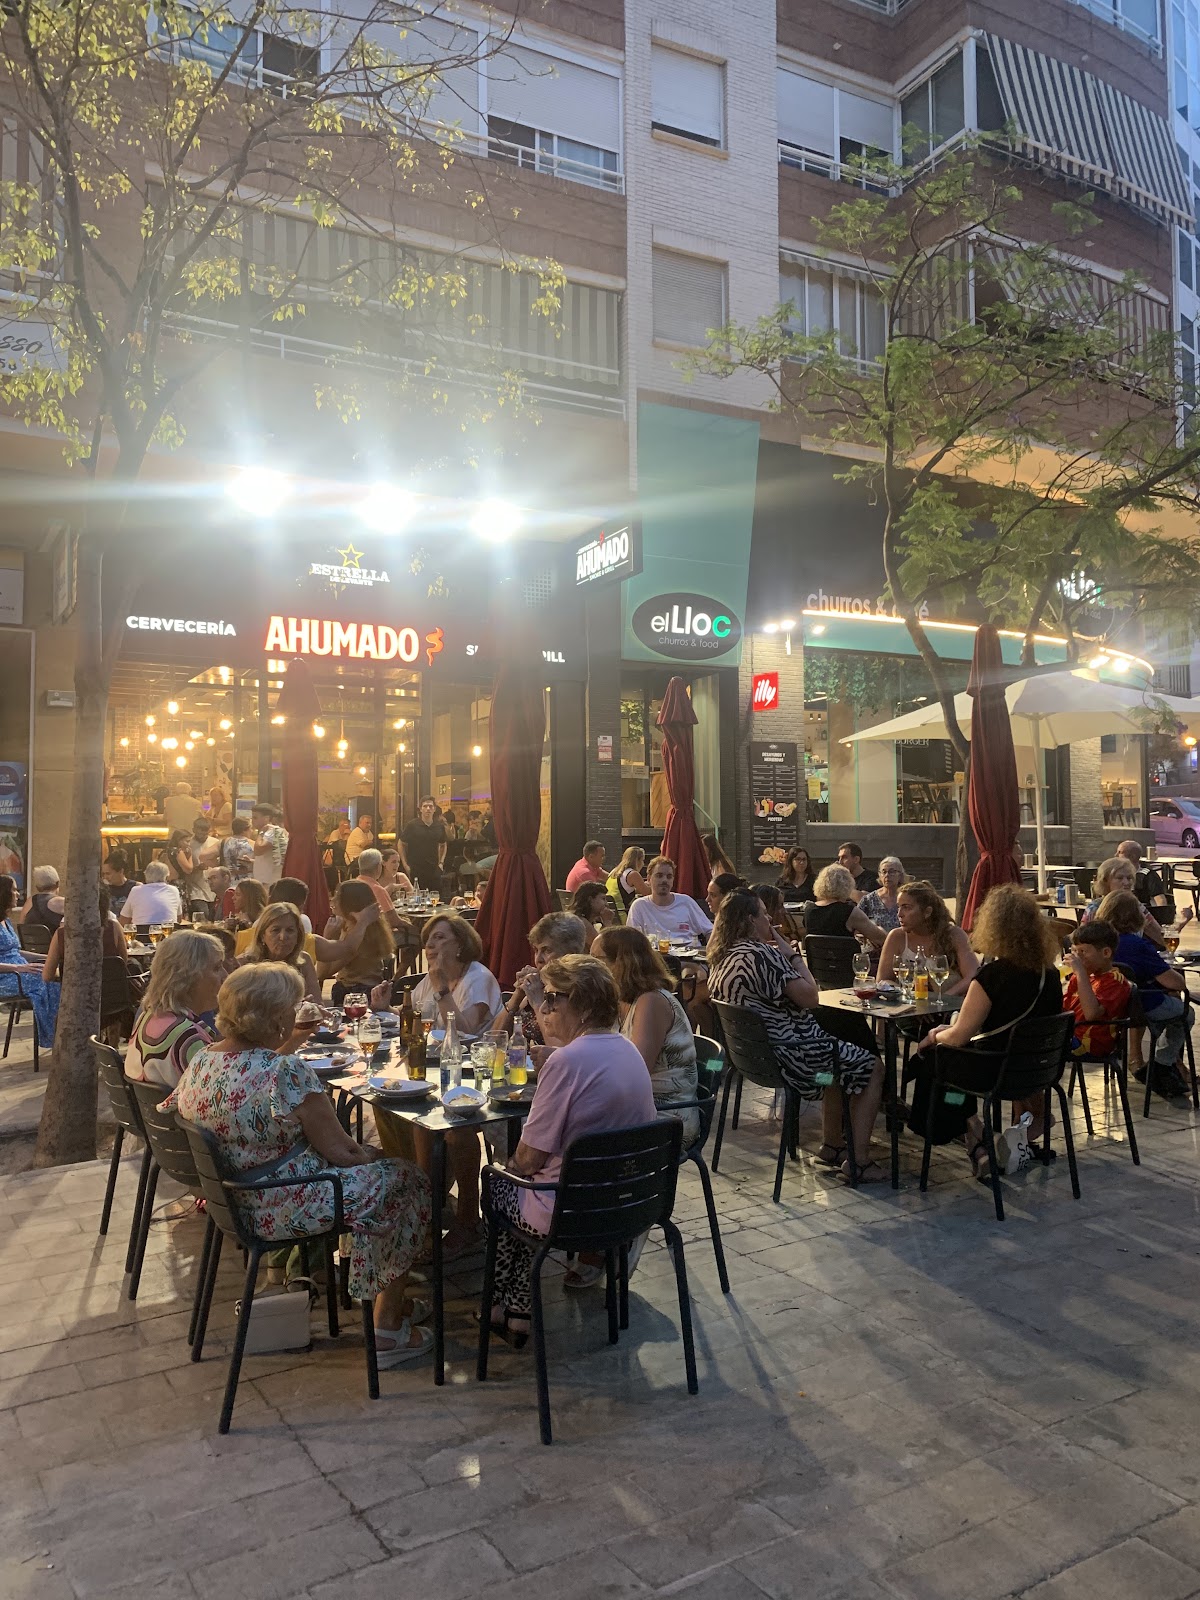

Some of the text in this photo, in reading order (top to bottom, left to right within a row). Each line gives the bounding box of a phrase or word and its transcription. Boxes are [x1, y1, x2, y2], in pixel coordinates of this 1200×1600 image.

[576, 532, 629, 581] AHUMADO
[311, 563, 390, 582] ESTRELLA
[806, 589, 871, 615] churros
[126, 616, 236, 636] CERVECERÍA
[264, 616, 419, 663] AHUMADO
[658, 636, 719, 649] churros & food
[754, 679, 777, 707] illy
